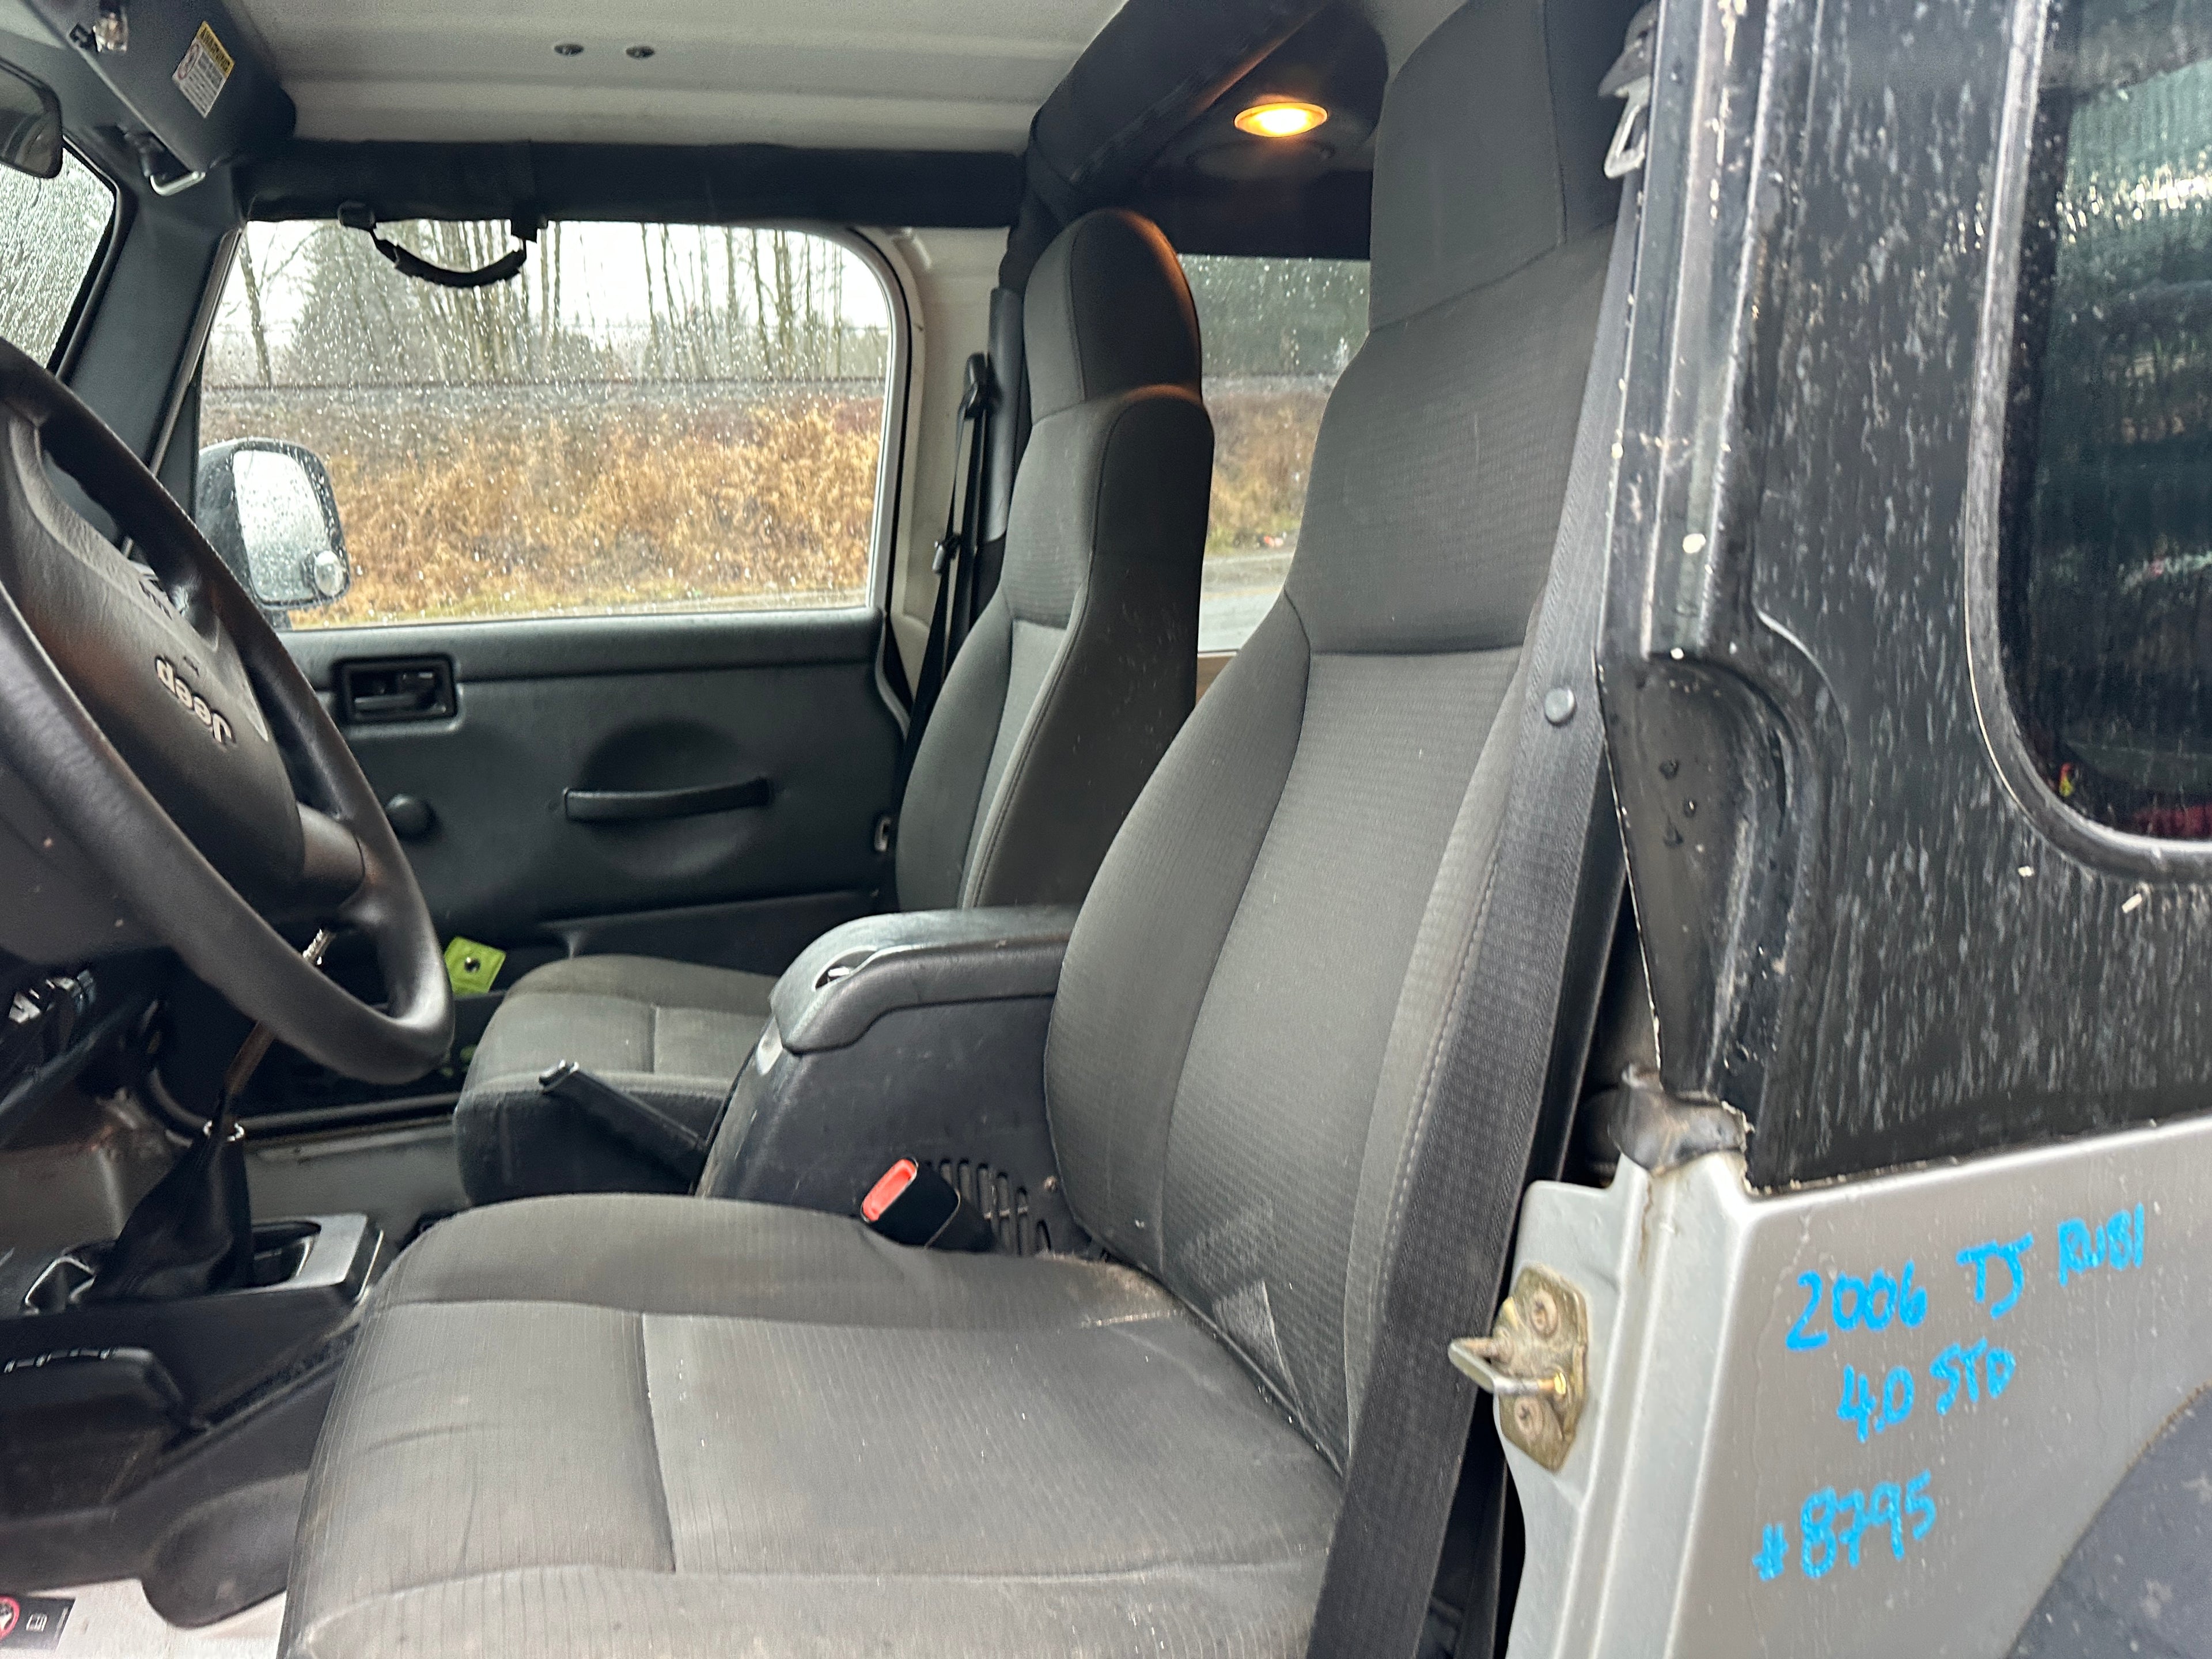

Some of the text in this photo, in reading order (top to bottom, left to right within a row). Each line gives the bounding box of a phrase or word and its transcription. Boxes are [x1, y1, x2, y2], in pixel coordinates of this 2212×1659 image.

[154, 656, 233, 744] Jeep
[1786, 1260, 1927, 1351] 2006
[1956, 1232, 2034, 1319] TJ
[1929, 1337, 2016, 1415] STD
